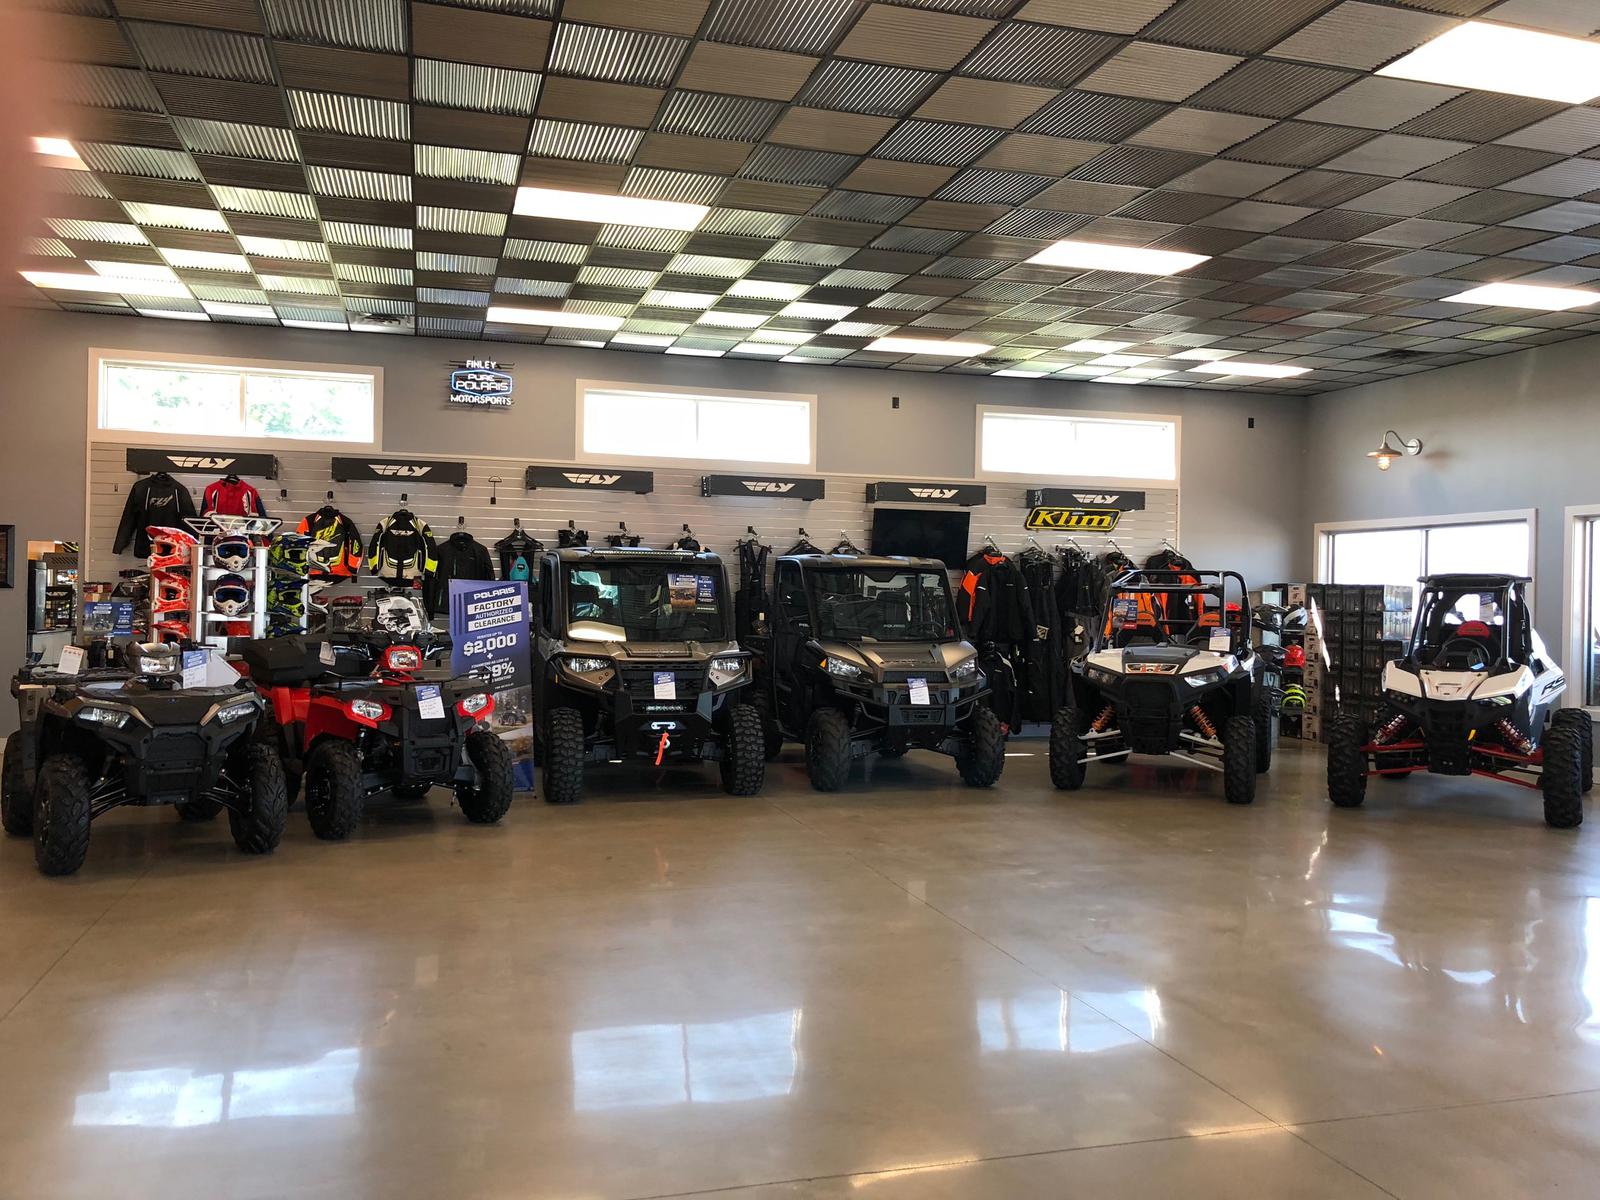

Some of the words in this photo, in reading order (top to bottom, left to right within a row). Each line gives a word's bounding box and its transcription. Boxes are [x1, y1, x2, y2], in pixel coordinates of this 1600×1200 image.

[466, 360, 497, 369] FINLEY
[468, 373, 495, 382] PURE
[456, 381, 509, 391] POLARIS
[450, 394, 512, 406] MOTORSPORTS
[181, 455, 236, 469] FLY
[382, 464, 433, 477] FLY
[576, 473, 622, 485] FLY
[754, 481, 796, 493] FLY
[920, 488, 960, 499] FLY
[1083, 494, 1120, 504] FLY
[474, 587, 516, 600] POLARIS
[474, 598, 515, 612] FACTORY
[475, 607, 513, 619] AUTHORIZED
[474, 615, 515, 629] CLEARANCE
[464, 633, 517, 656] $2,000
